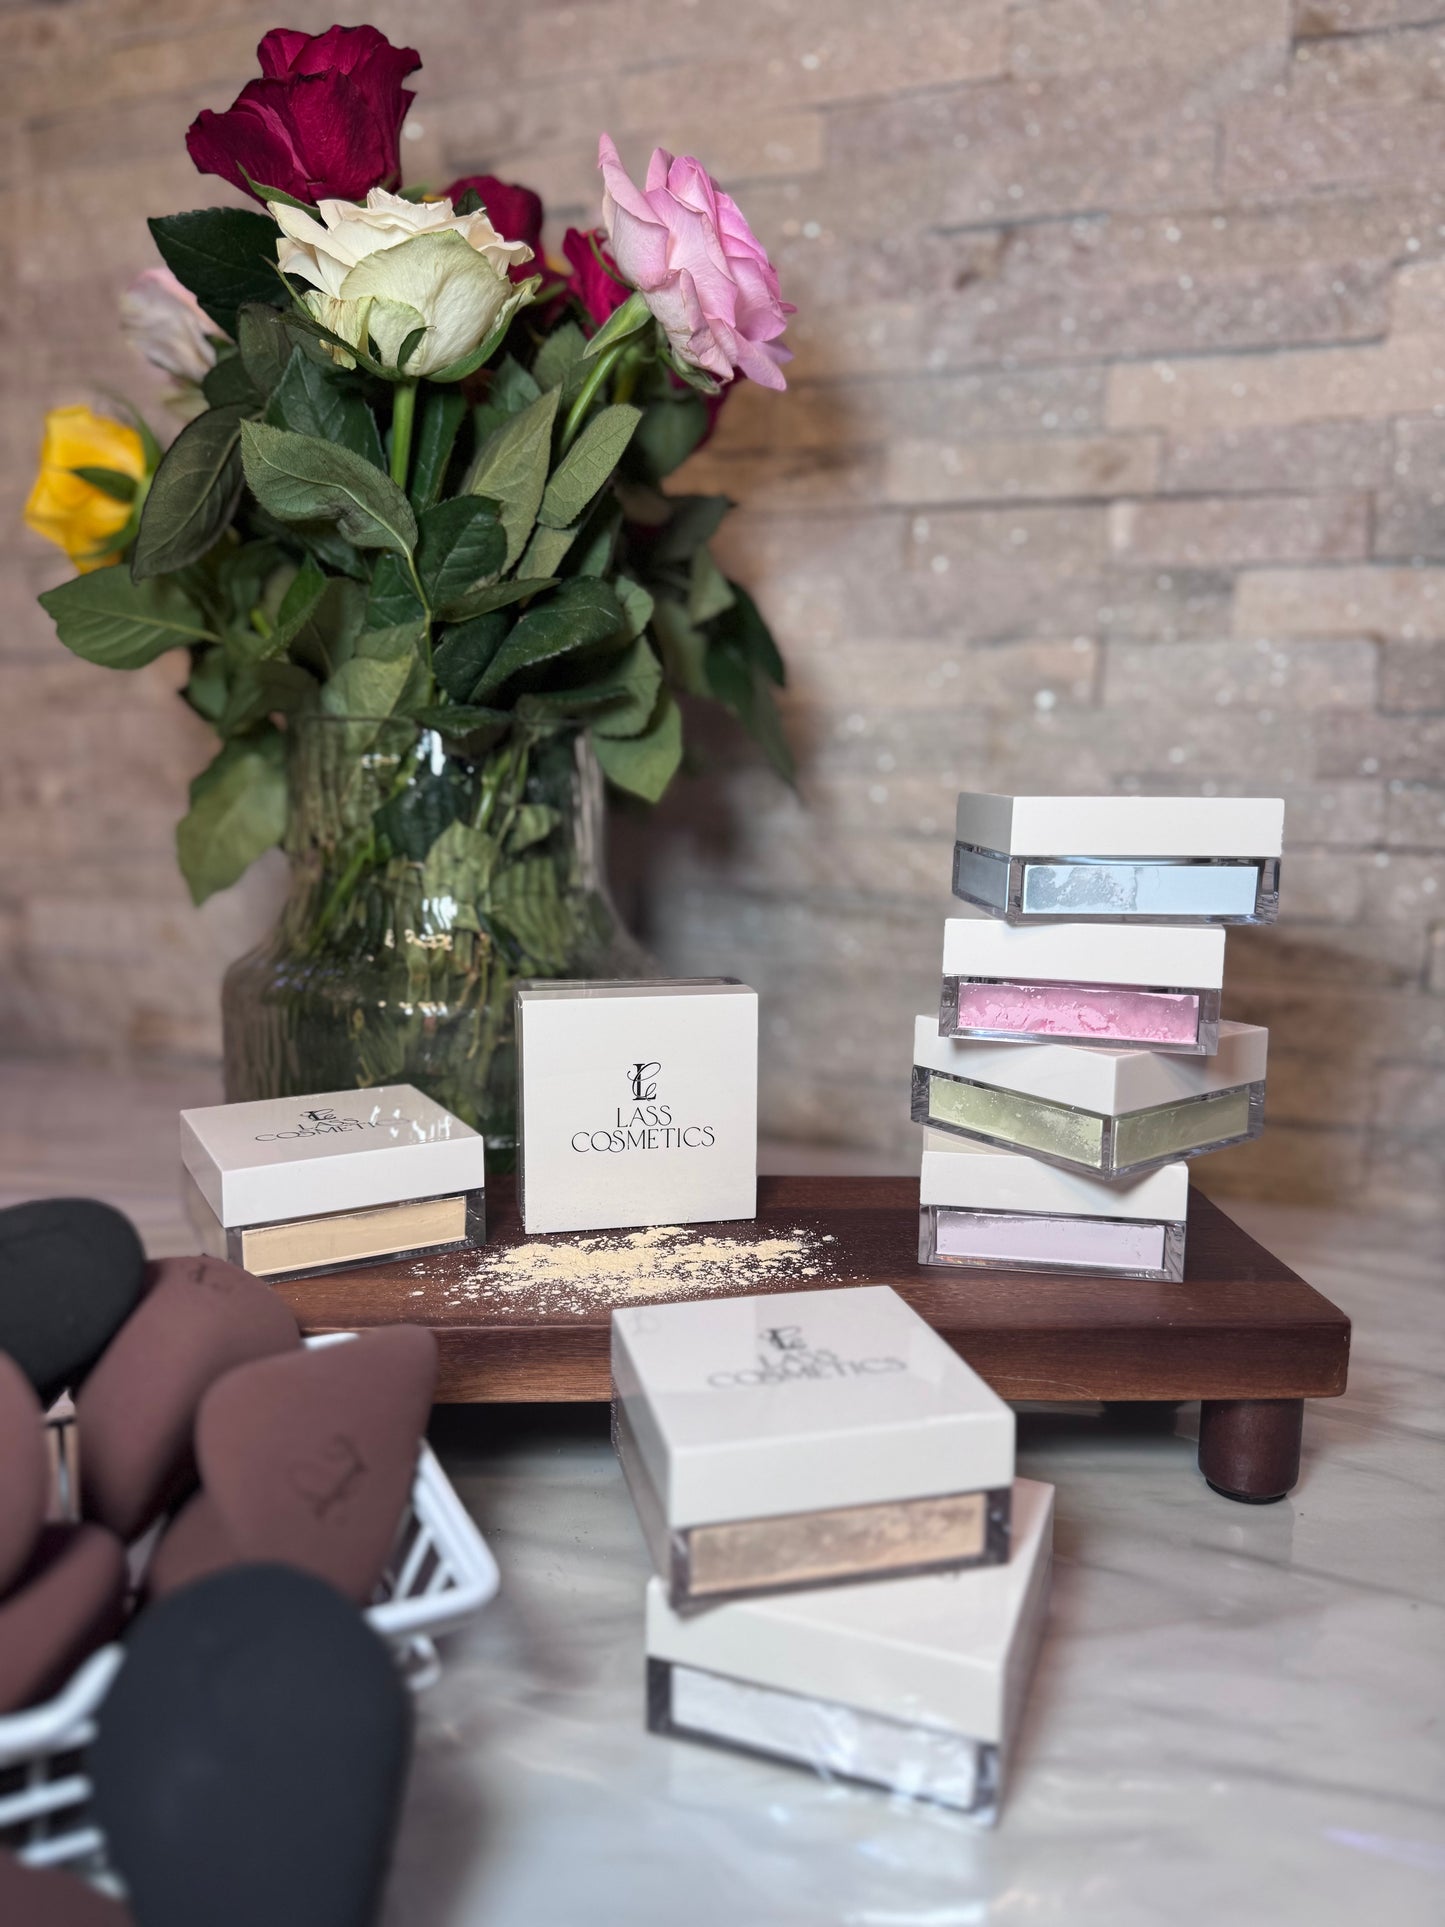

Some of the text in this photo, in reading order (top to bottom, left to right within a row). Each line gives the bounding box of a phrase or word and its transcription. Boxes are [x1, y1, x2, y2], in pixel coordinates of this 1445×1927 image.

[298, 1118, 359, 1130] LASS
[617, 1105, 672, 1128] LASS
[255, 1118, 411, 1142] COSMETICS
[571, 1126, 715, 1153] COSMETICS
